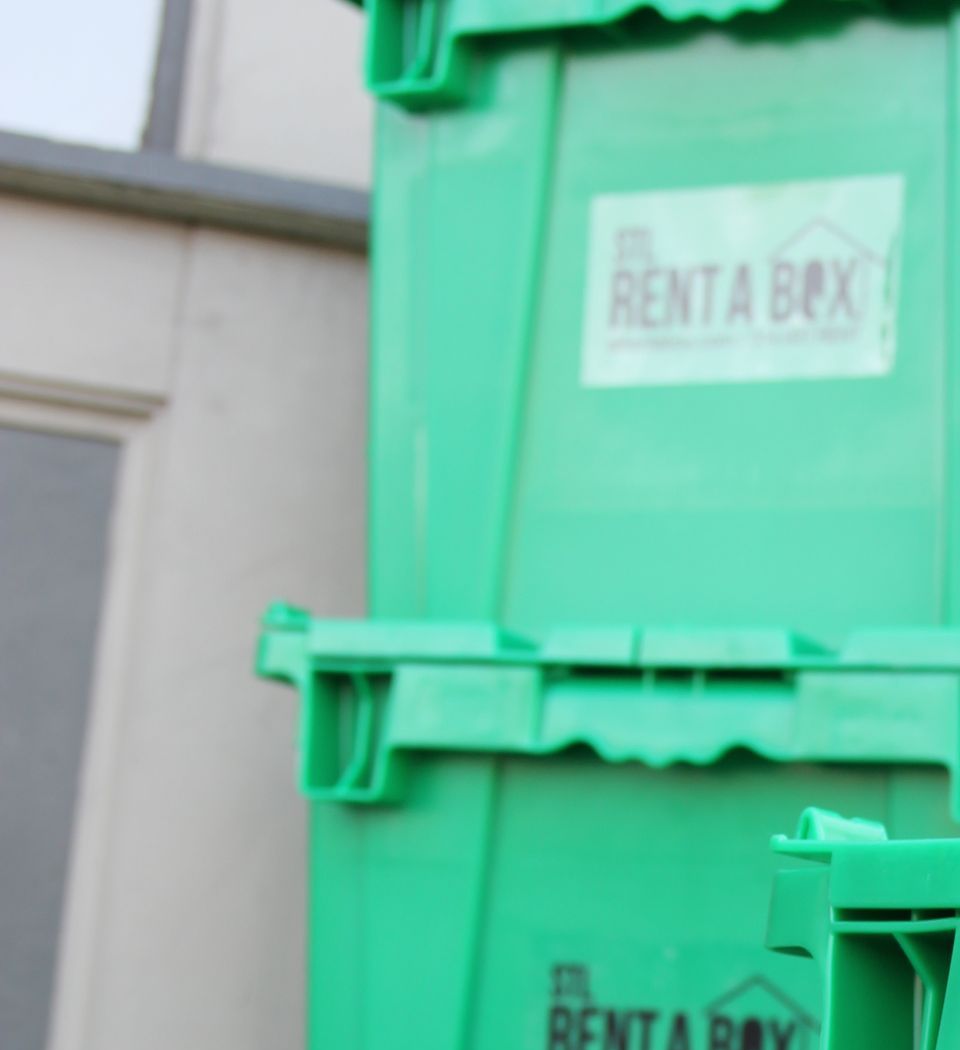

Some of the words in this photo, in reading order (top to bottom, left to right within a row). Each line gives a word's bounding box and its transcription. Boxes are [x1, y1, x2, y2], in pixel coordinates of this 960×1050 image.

[608, 263, 723, 330] RENT
[724, 261, 754, 325] A
[769, 258, 858, 326] BOX
